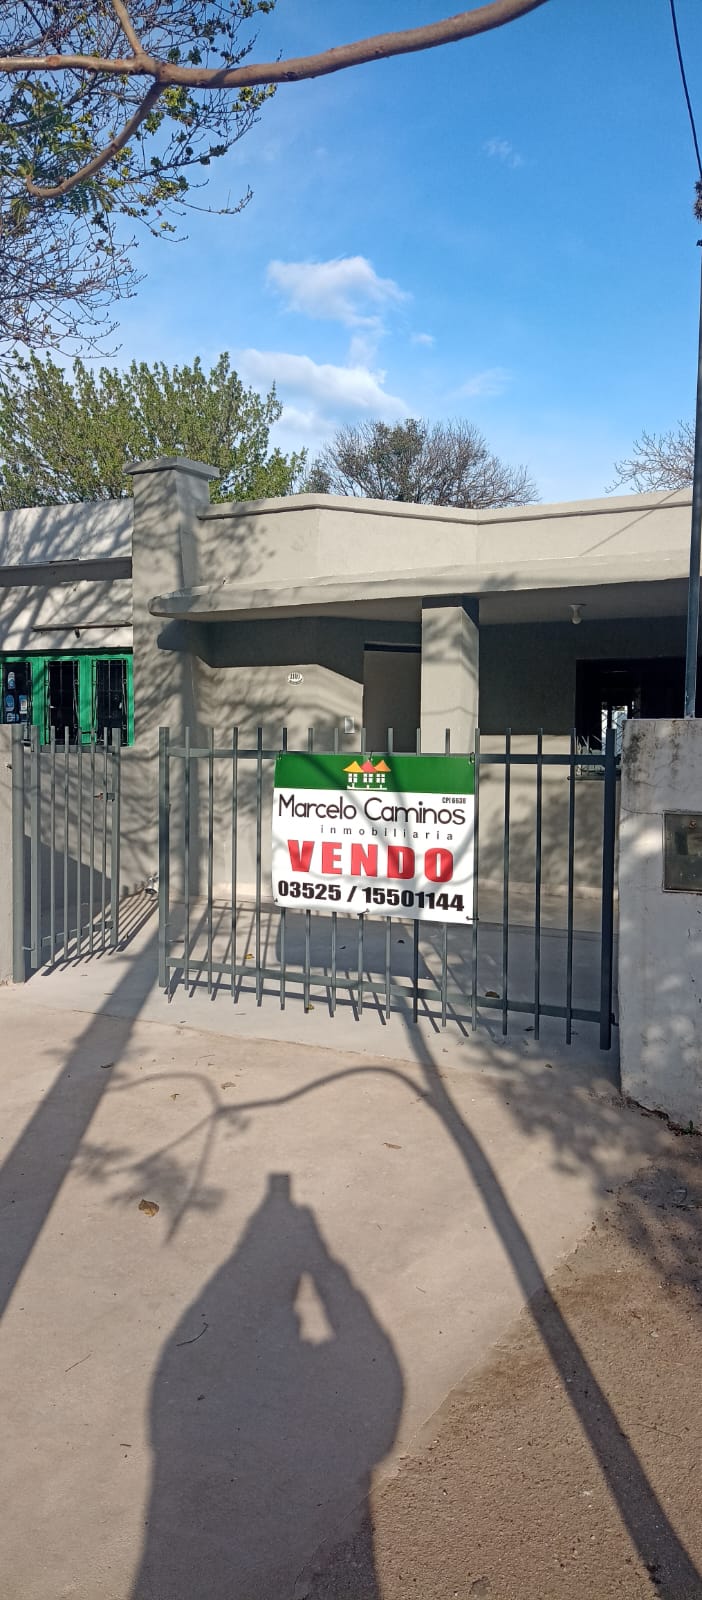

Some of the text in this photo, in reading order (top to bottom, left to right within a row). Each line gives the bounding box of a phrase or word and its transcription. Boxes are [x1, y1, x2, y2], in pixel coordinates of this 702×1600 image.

[278, 793, 466, 826] Marcelo Caminos
[320, 824, 454, 841] inmobiliaria
[287, 839, 455, 884] VENDO
[278, 880, 465, 912] 03525 / 15501144
